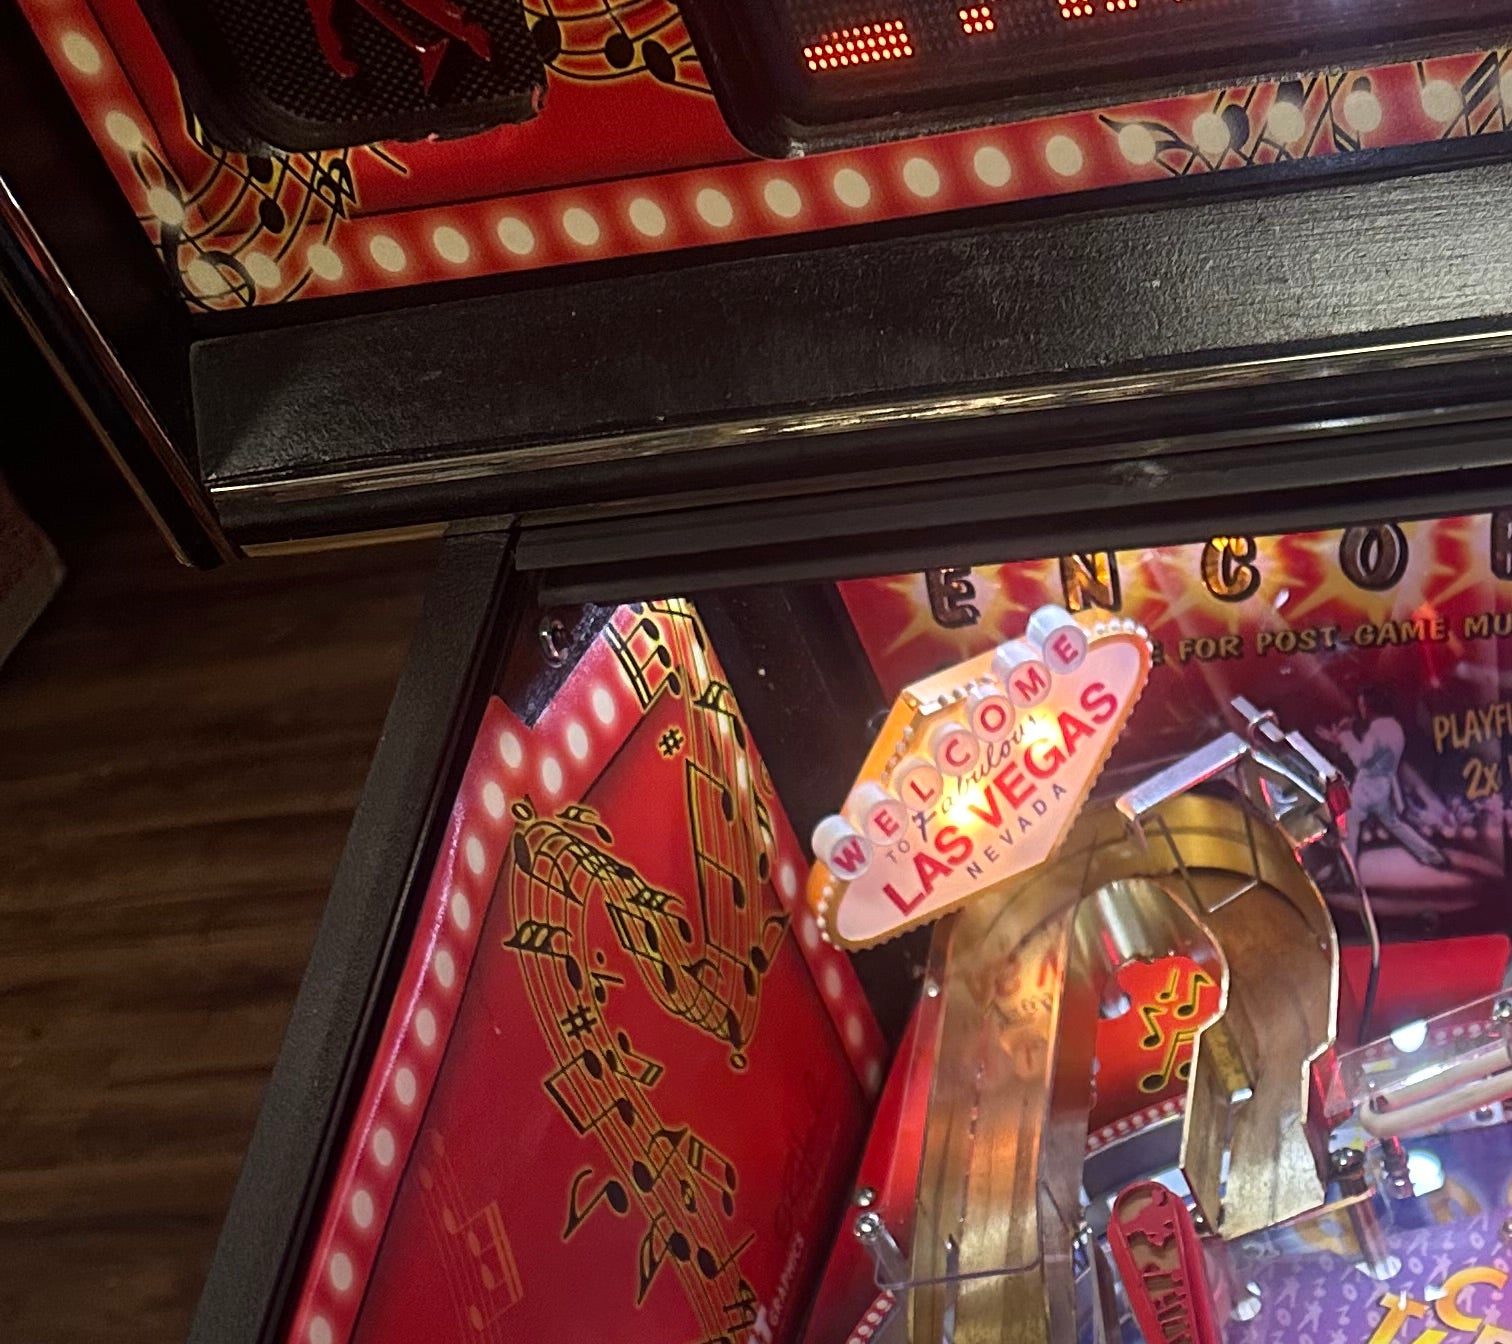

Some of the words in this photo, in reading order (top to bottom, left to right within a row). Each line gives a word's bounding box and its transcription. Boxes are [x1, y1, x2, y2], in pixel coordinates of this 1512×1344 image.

[1179, 634, 1242, 662] FOR
[1256, 618, 1450, 654] POST-GAME
[829, 633, 1081, 876] WELCOME
[883, 824, 974, 916] LAS
[969, 681, 1119, 828] VEGAS
[967, 782, 1067, 881] NEVADA
